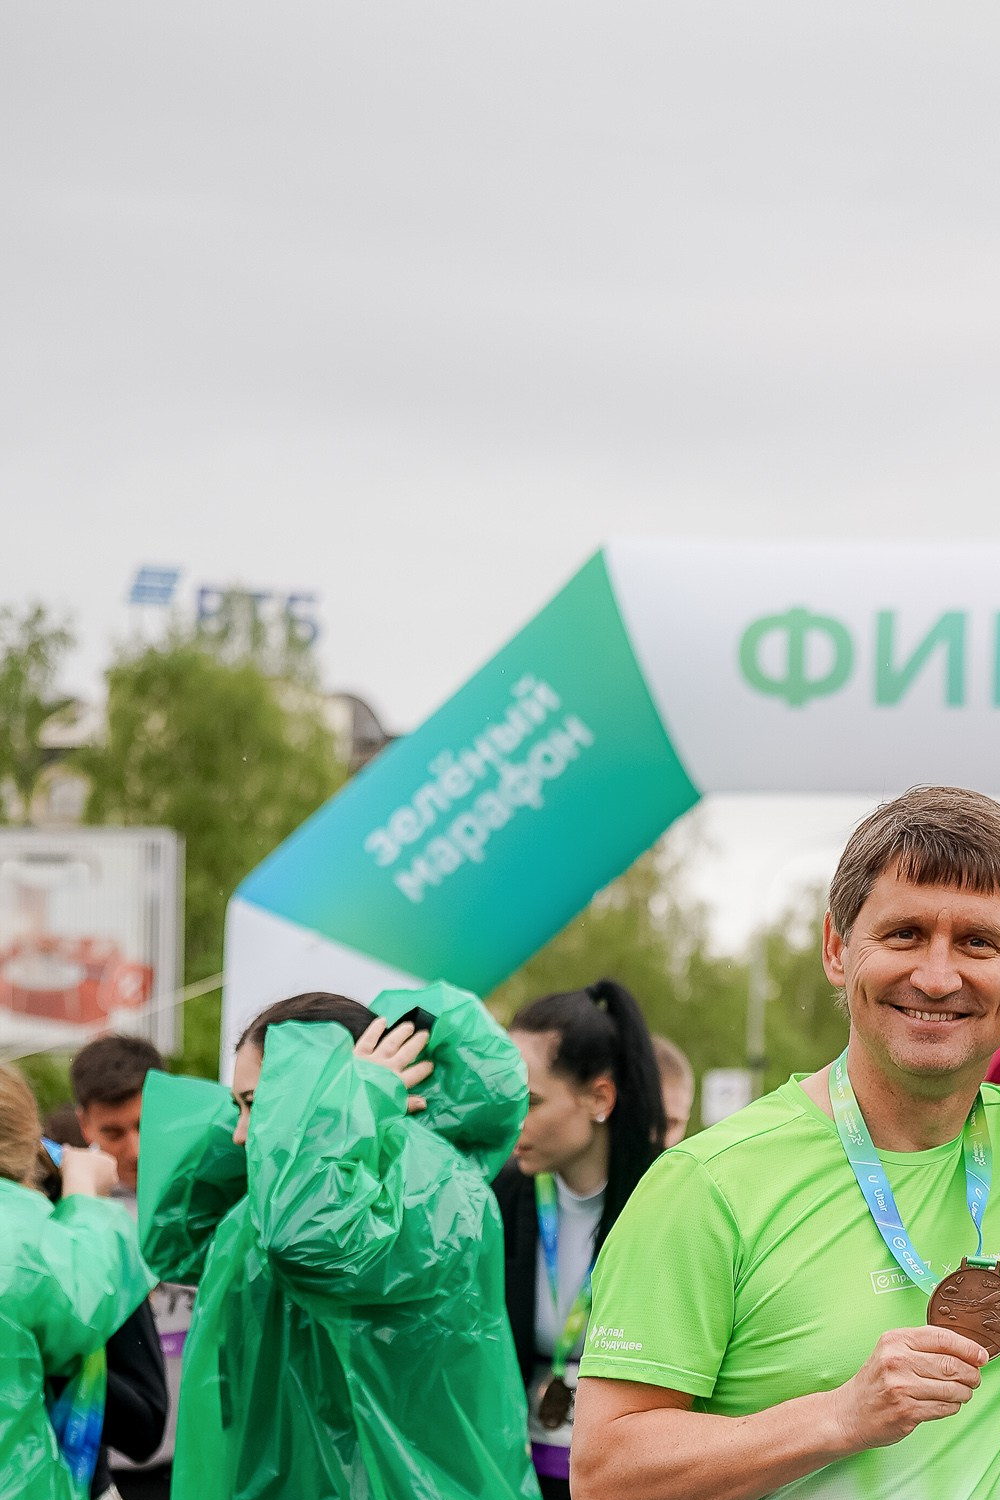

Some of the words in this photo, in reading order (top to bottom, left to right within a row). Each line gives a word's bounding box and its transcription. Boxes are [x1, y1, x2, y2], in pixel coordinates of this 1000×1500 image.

[364, 674, 563, 866] зелёный
[395, 714, 594, 902] марафон
[874, 1188, 888, 1212] Utair
[902, 1251, 925, 1276] СБЕР
[600, 1337, 643, 1351] будущее
